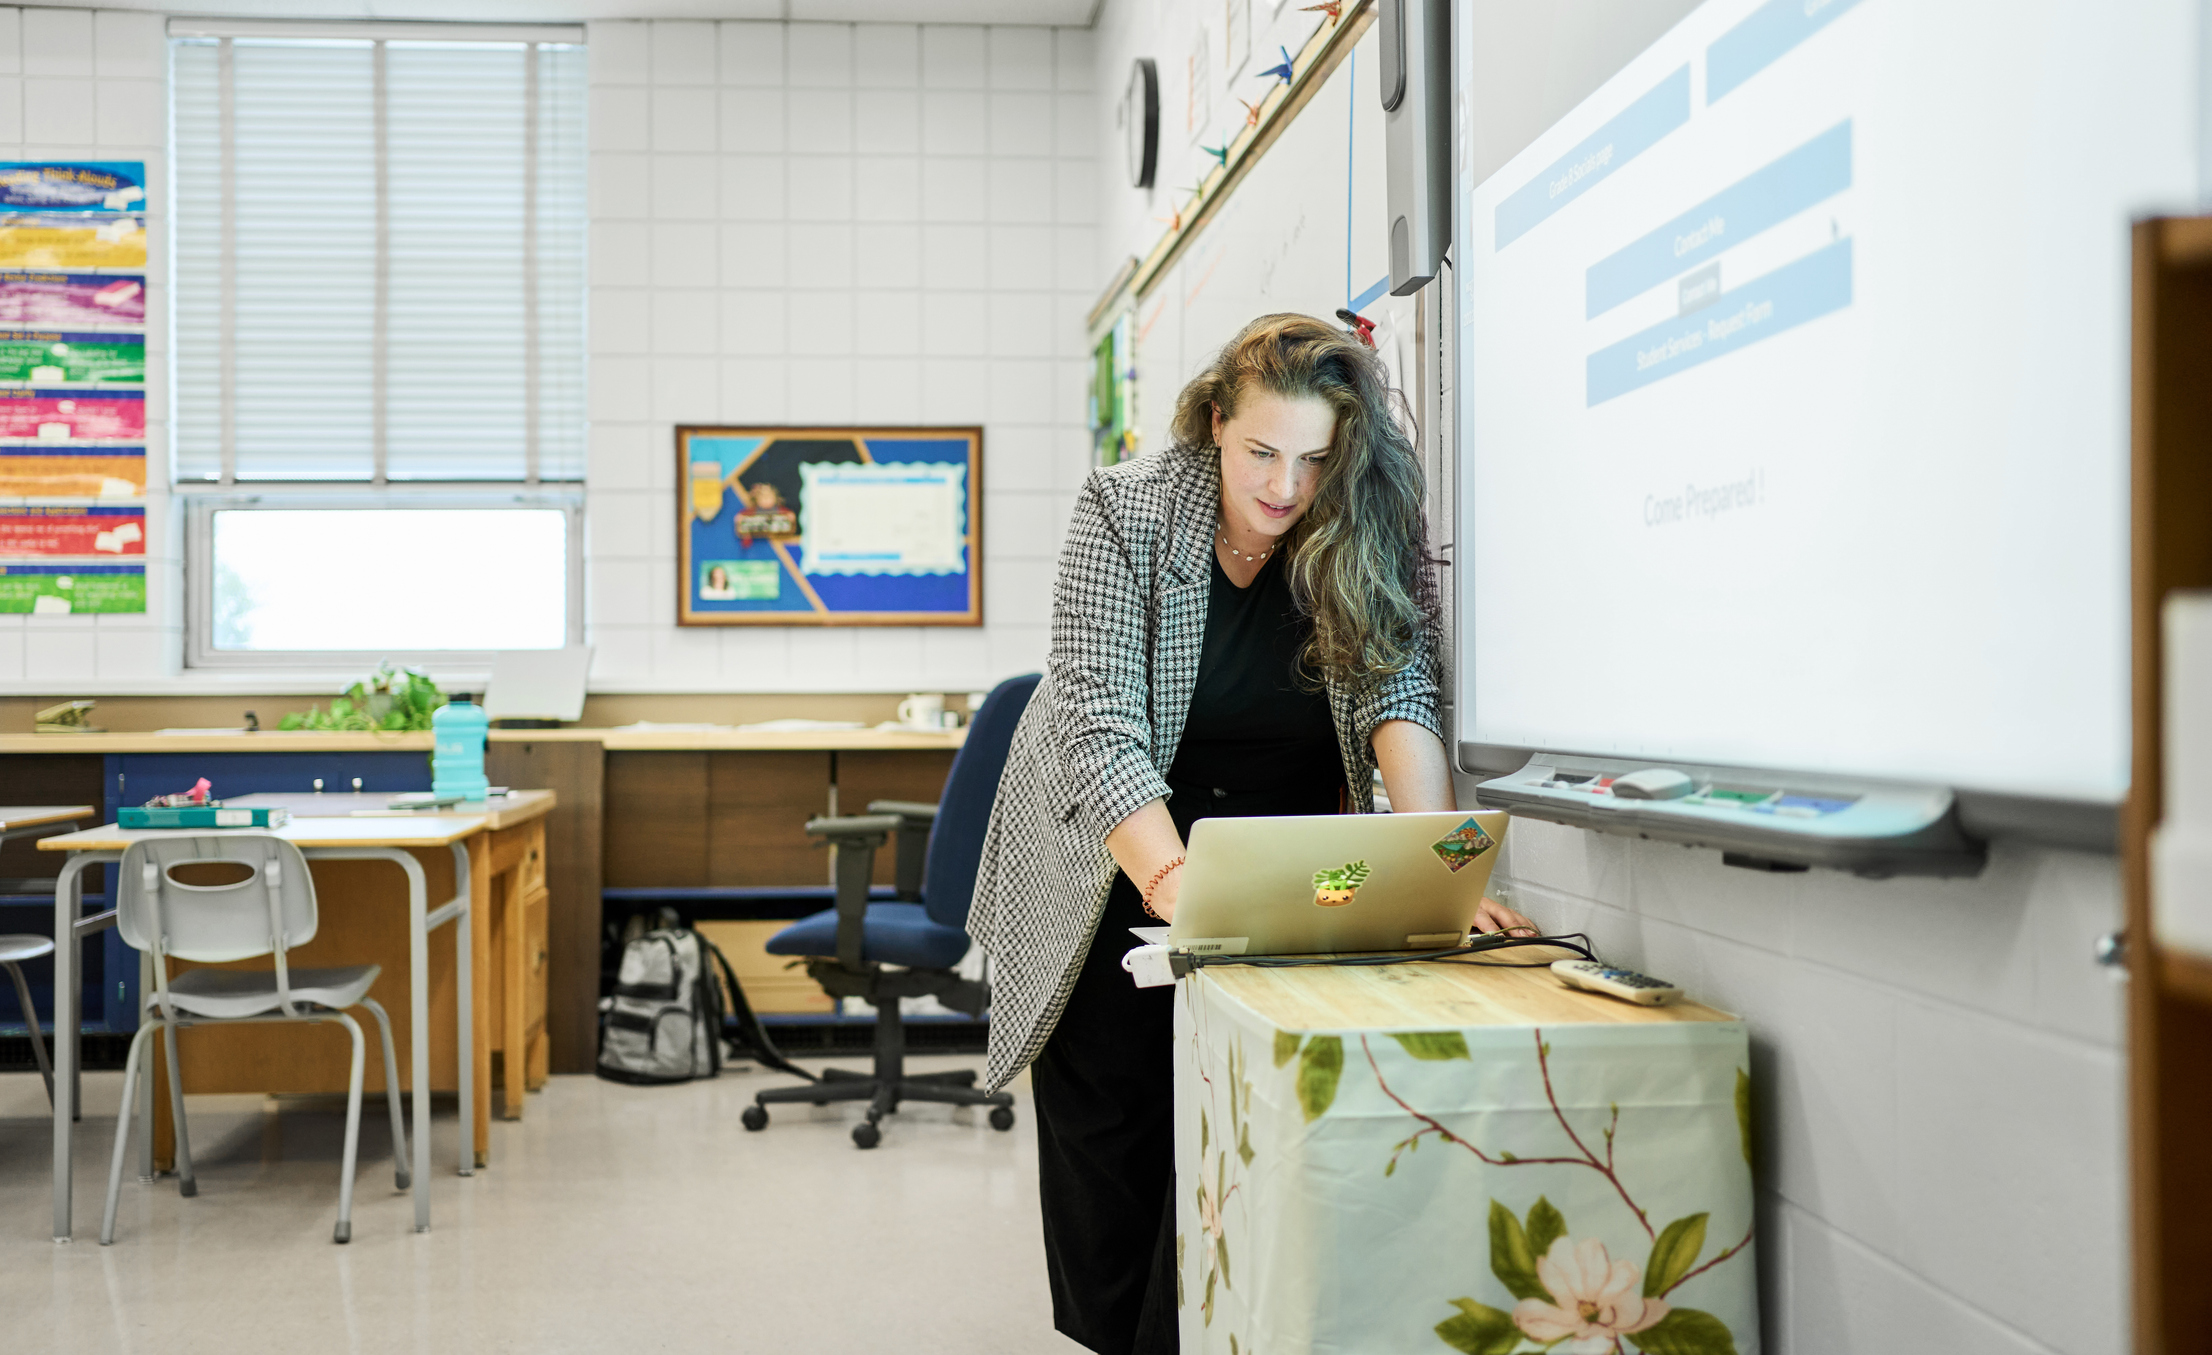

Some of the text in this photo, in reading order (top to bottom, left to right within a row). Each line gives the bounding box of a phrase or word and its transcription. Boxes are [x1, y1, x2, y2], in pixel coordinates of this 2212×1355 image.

[1549, 173, 1568, 199] Grade
[1596, 143, 1613, 171] page
[1636, 342, 1667, 371] Student
[1667, 330, 1703, 358] Services
[1643, 492, 1683, 527] Come
[1685, 467, 1756, 521] Prepared
